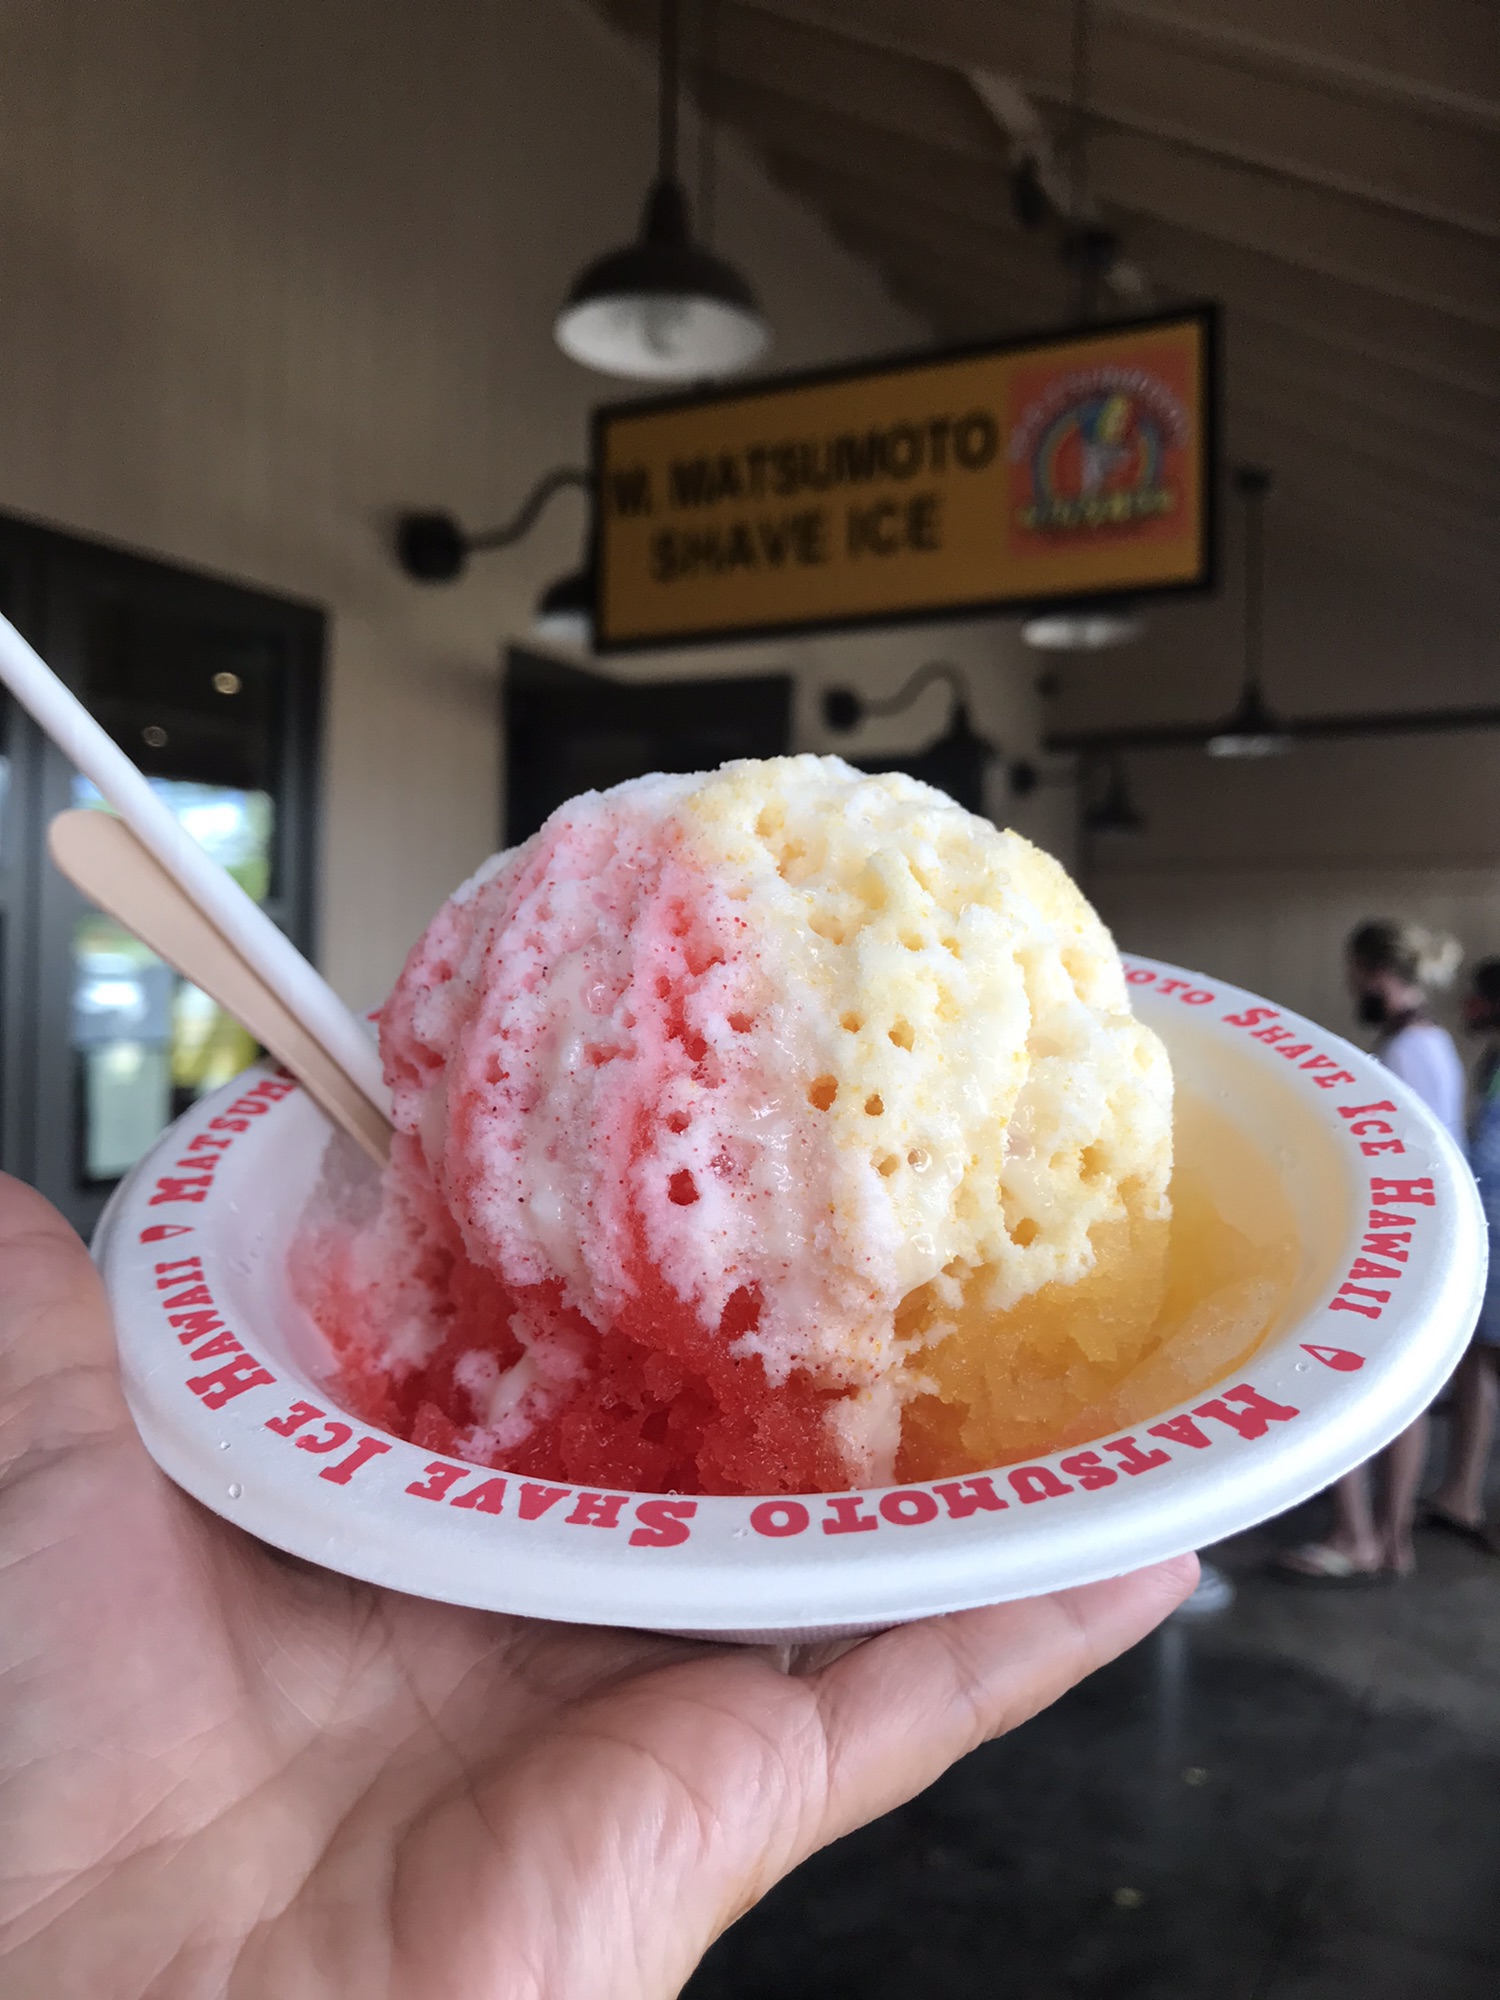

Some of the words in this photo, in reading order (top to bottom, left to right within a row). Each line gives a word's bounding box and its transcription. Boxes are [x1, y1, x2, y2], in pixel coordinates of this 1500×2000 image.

[668, 407, 999, 510] MATSUMOTO
[651, 507, 829, 588] SHAVE
[847, 492, 945, 563] ICE
[1121, 963, 1215, 1005] OTO
[1221, 1008, 1356, 1089] SHAVE
[1337, 1101, 1406, 1158] ICE
[1328, 1177, 1436, 1320] HAWAII
[155, 1257, 277, 1411] HAWAII
[265, 1401, 393, 1486] ICE
[749, 1384, 1300, 1538] MATSUMOTO
[405, 1461, 698, 1548] SHAVE
